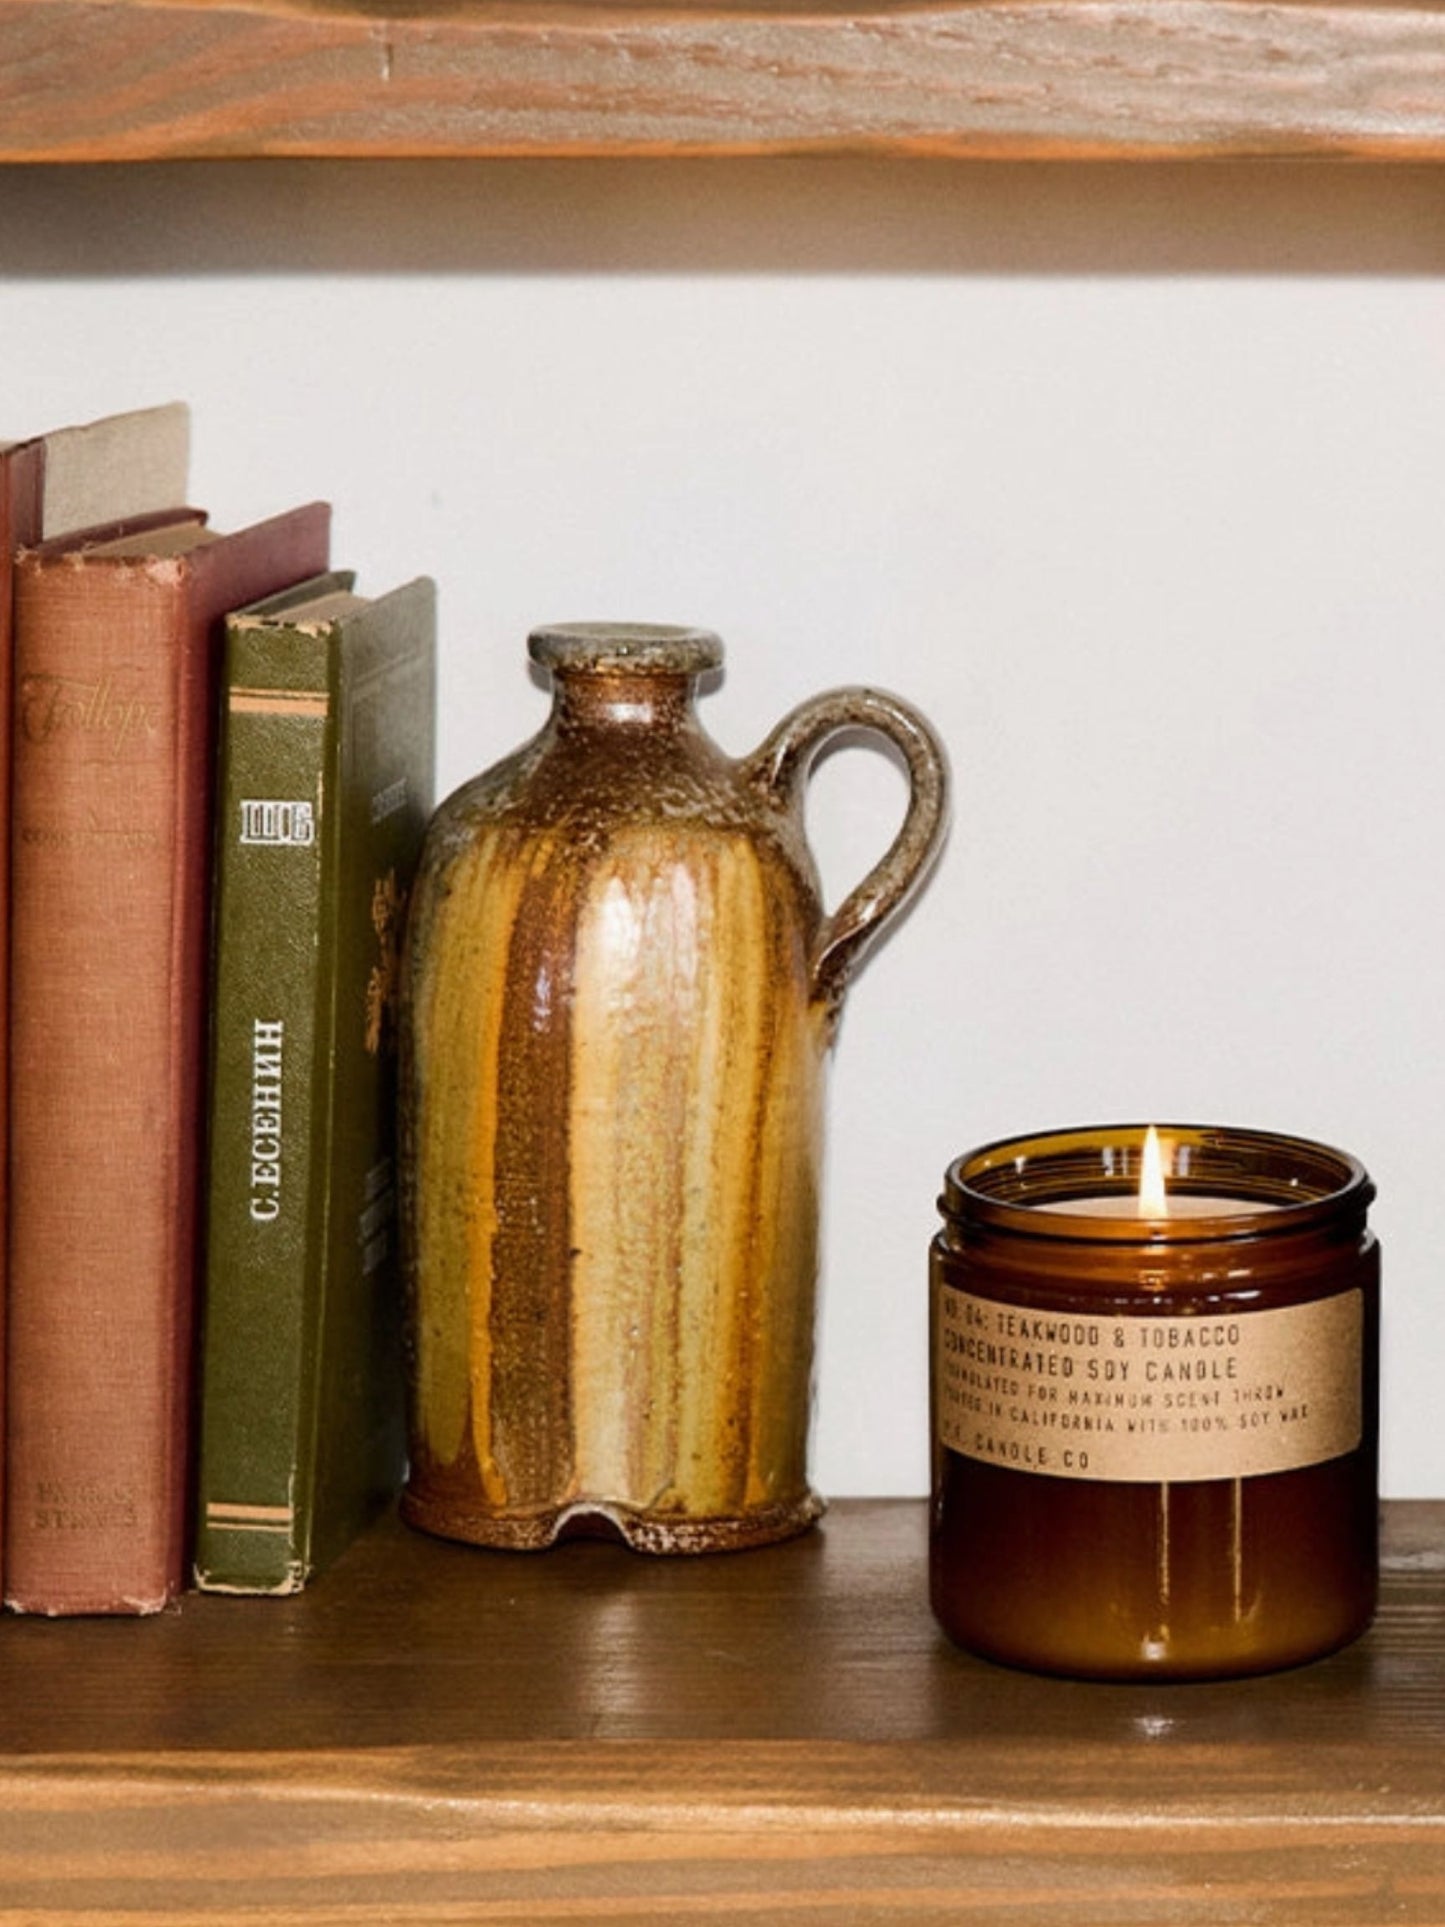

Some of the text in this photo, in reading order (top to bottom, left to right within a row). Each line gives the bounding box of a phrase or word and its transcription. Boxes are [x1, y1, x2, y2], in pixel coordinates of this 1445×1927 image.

[997, 1313, 1100, 1346] TEAKWOOD
[1113, 1327, 1125, 1349] &
[1139, 1324, 1241, 1349] TOBACCO
[944, 1328, 1239, 1382] CONCENTRATED SOY CANDLE
[1028, 1385, 1058, 1402] FOR
[1068, 1391, 1153, 1409] MAXIMUM
[1163, 1391, 1221, 1409] SCENT
[989, 1400, 1002, 1417] IN
[1010, 1406, 1115, 1432] CALIFORNIA
[1181, 1417, 1229, 1433] 100%
[1239, 1411, 1270, 1431] SOY
[976, 1433, 1048, 1466] CANDLE
